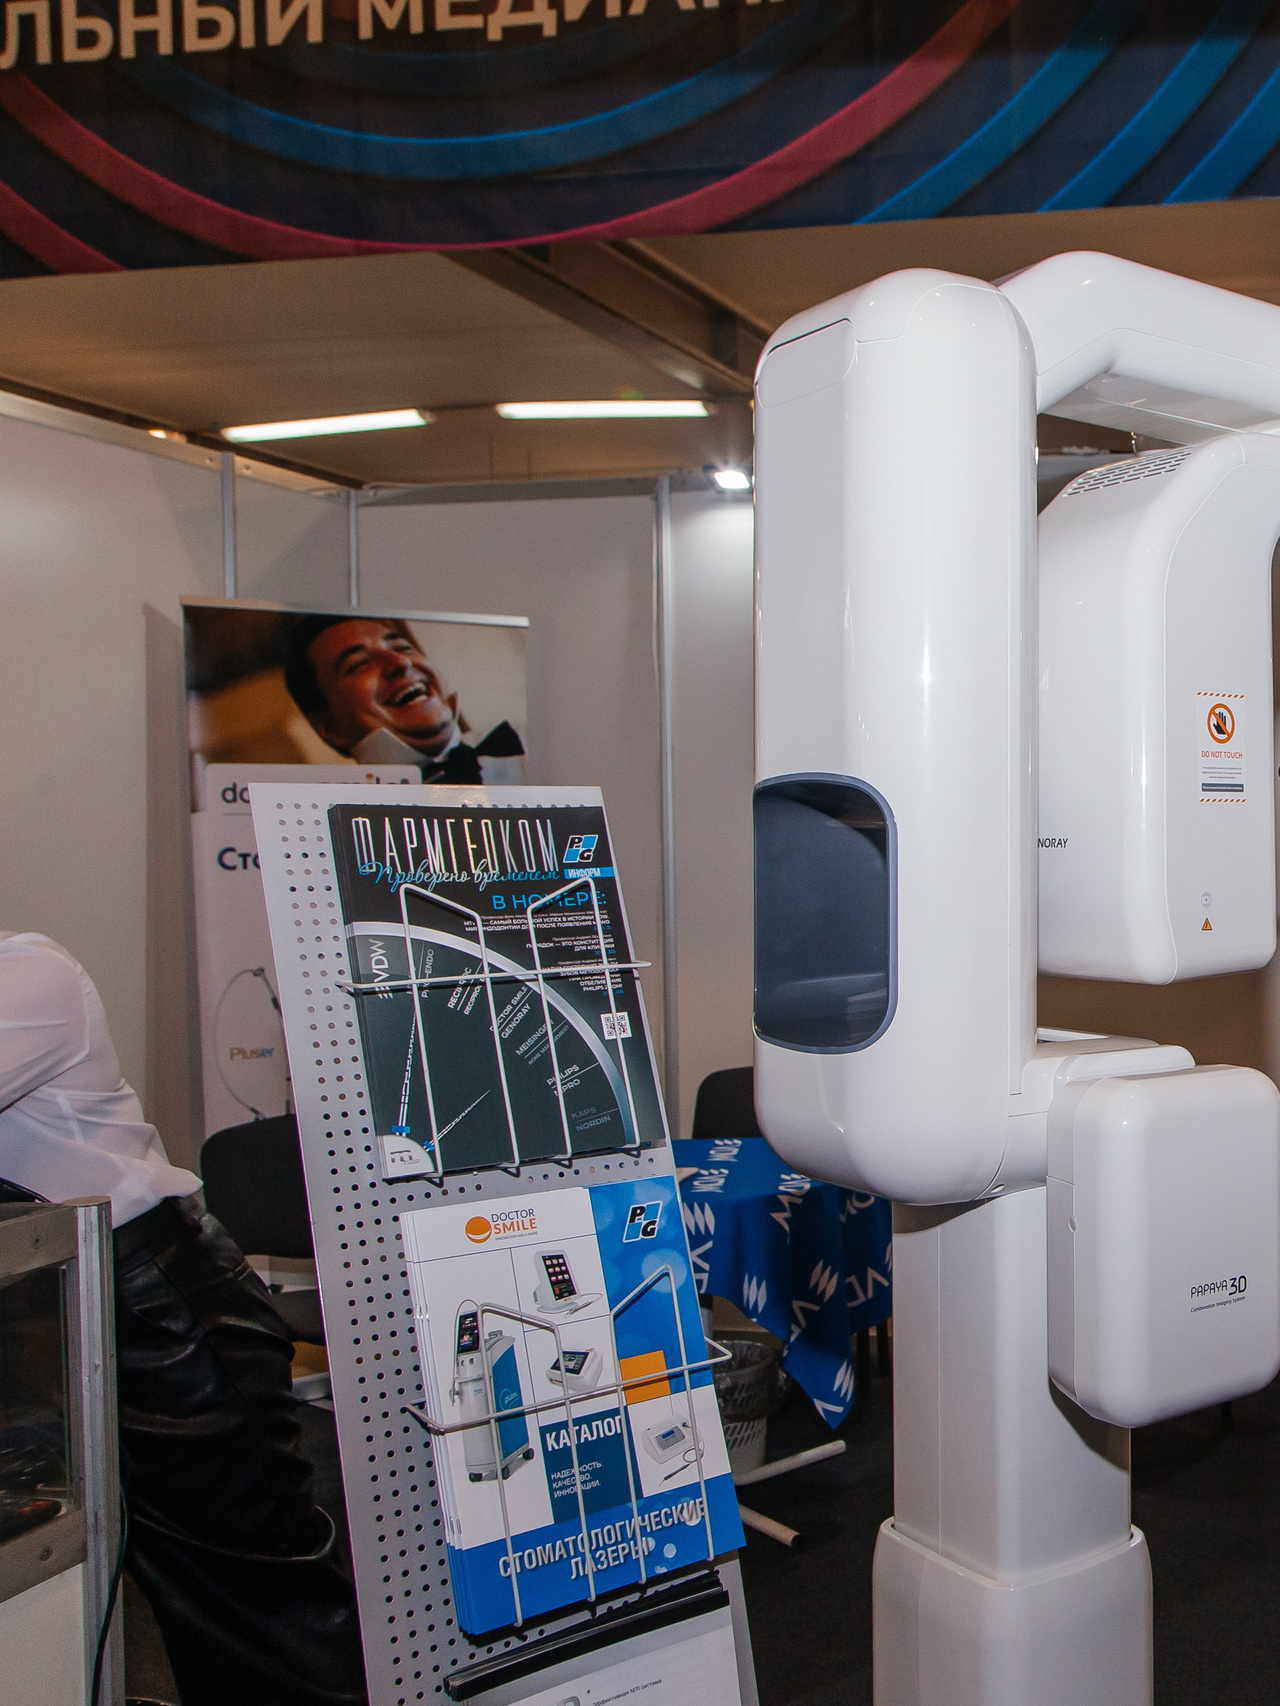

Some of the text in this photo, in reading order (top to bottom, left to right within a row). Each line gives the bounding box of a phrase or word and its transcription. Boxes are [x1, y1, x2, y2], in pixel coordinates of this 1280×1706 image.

[1201, 750, 1243, 759] DO NOT TOUCH
[352, 817, 559, 874] ФАРМГЕОКОМ
[1037, 837, 1069, 848] NORAY
[358, 858, 560, 893] Проверено временем
[567, 868, 601, 879] ИНФОРМ
[492, 895, 506, 910] В
[368, 938, 390, 983] VDW
[511, 985, 528, 1006] SMILE
[501, 1003, 532, 1039] GENORAY
[553, 1078, 581, 1097] NPRO
[571, 1106, 597, 1119] KAPS
[575, 1115, 611, 1132] NORDIN
[491, 1208, 536, 1223] DOCTOR
[494, 1218, 537, 1235] SMILE
[1190, 1275, 1247, 1299] PAPAYA 3D
[545, 1415, 622, 1452] КАТАЛОГ
[552, 1473, 593, 1489] КАЧЕСВО.
[571, 1536, 654, 1580] ЛАЗЕРЫ
